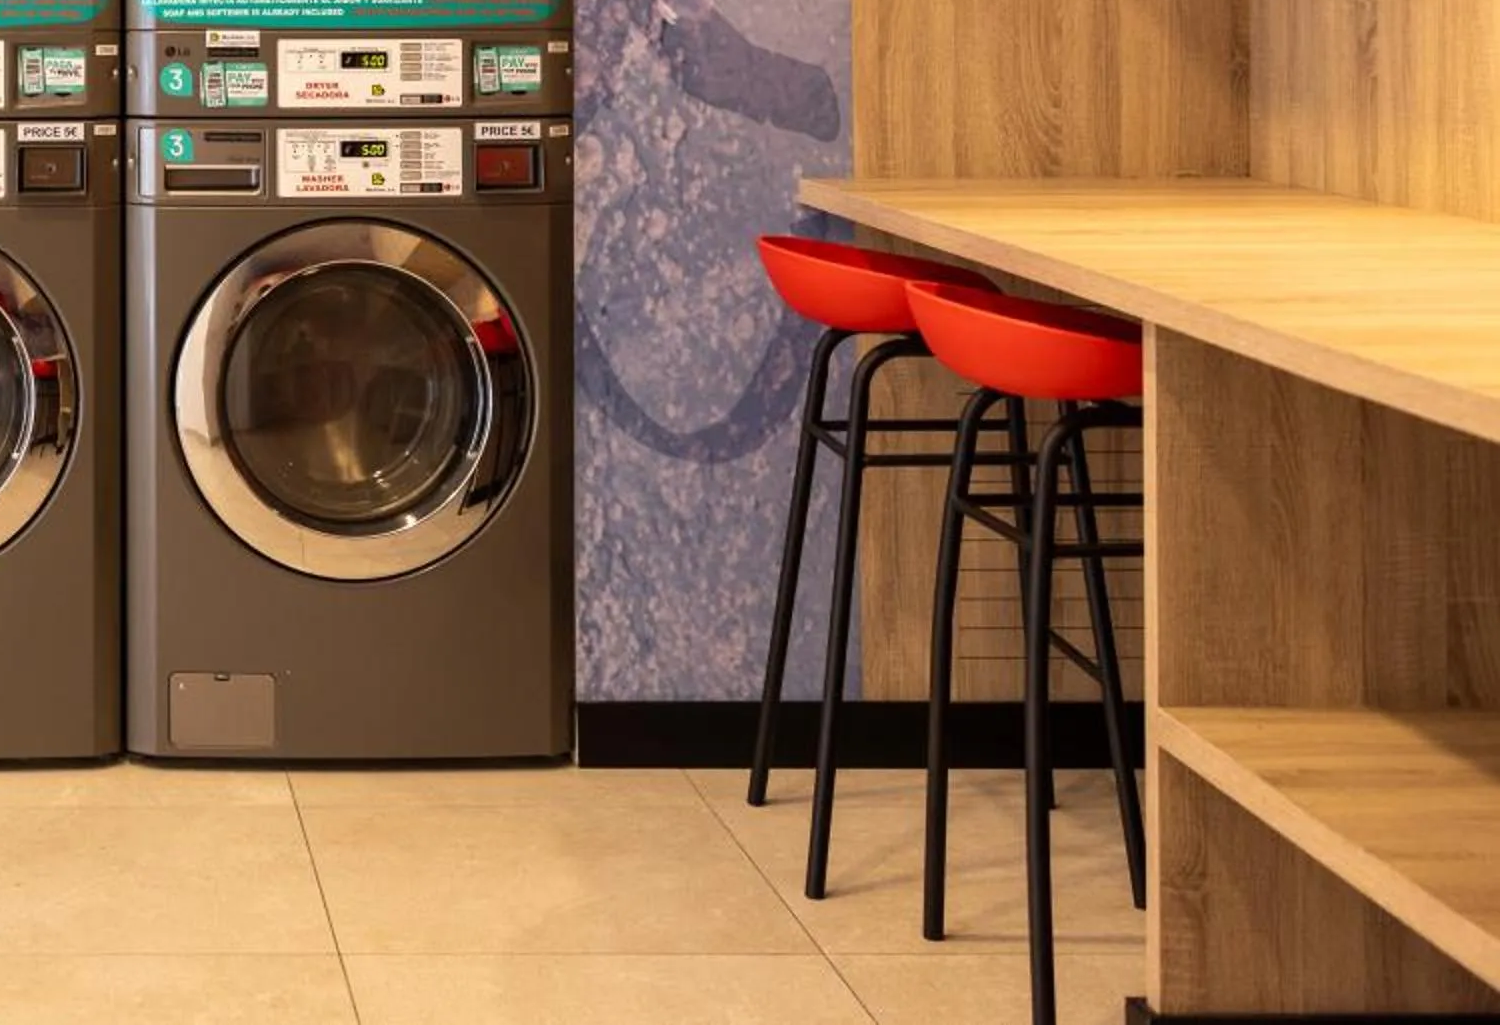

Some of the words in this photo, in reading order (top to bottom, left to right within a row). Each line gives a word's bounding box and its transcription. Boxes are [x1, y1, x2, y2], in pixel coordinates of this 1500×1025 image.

[168, 68, 183, 90] 3
[305, 82, 339, 90] DRYER
[23, 126, 61, 138] PRICE
[481, 126, 517, 136] PRICE
[169, 135, 184, 156] 3
[301, 175, 344, 183] WASHER
